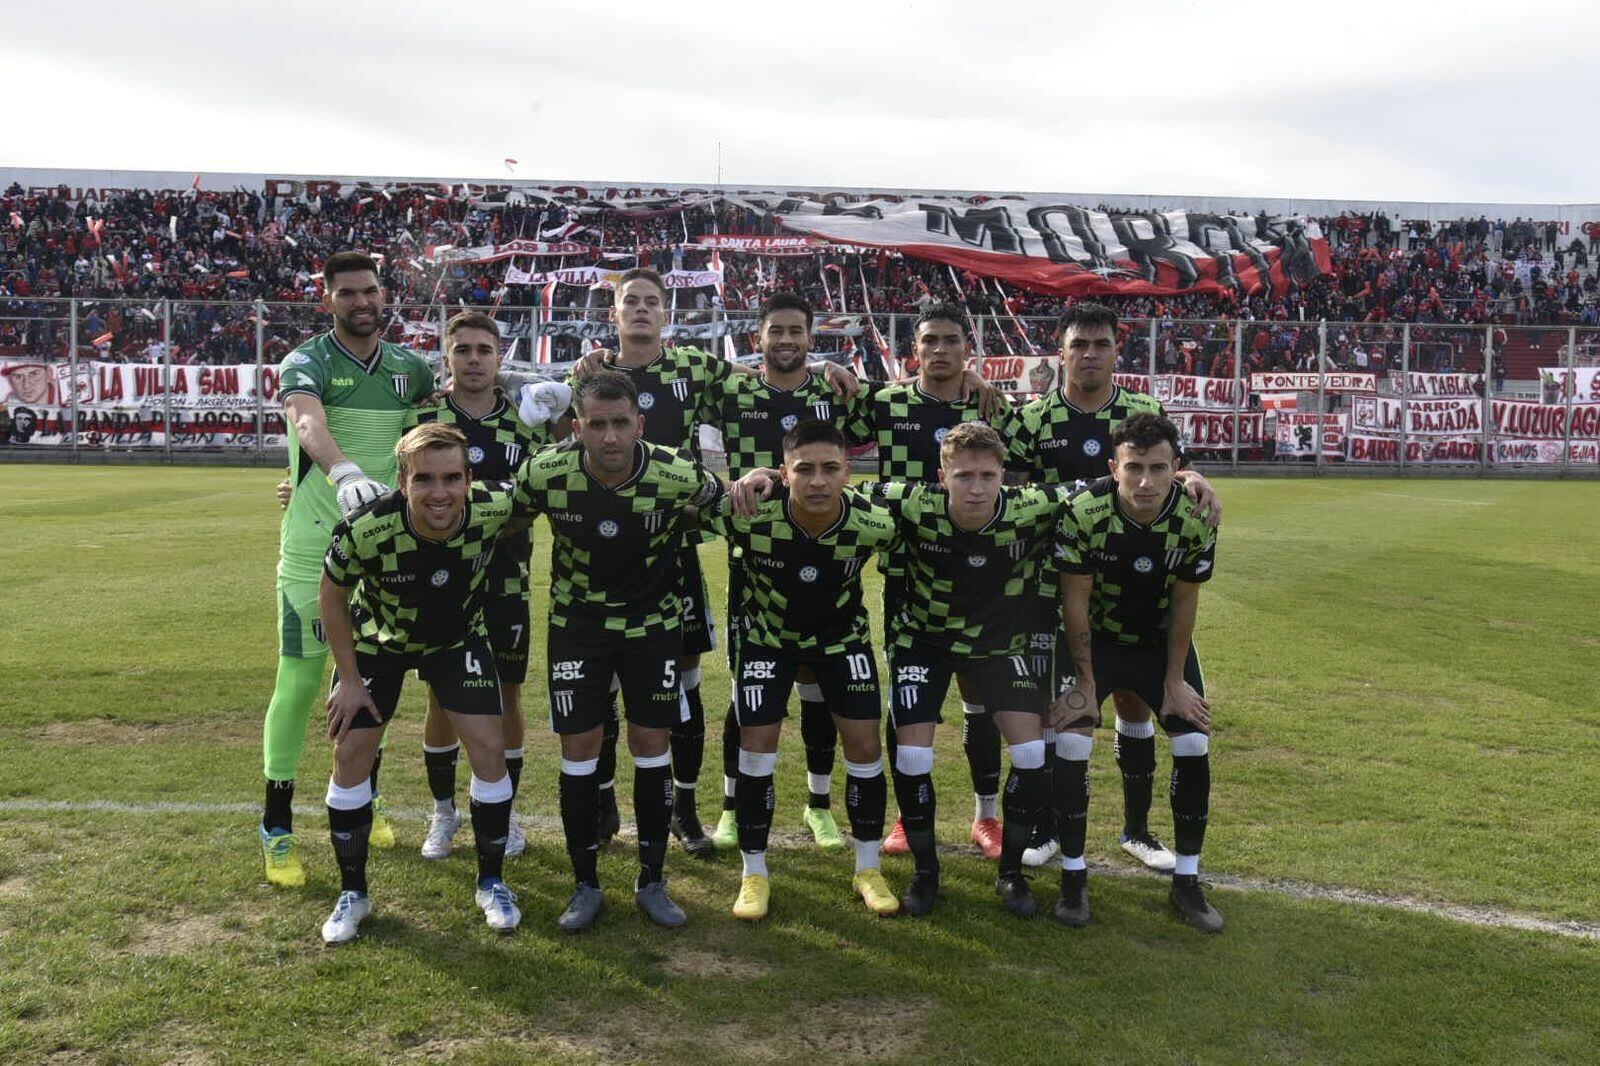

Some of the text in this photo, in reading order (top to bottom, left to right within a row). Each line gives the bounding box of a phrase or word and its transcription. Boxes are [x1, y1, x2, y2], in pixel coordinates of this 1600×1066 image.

[720, 237, 761, 248] SANTA
[528, 272, 552, 283] LA
[555, 270, 600, 284] VILLA
[100, 366, 124, 400] LA
[135, 366, 188, 396] VILA
[199, 366, 240, 396] SAN
[1174, 376, 1199, 398] DEL
[1408, 374, 1474, 396] LA TABLA
[741, 411, 769, 420] mitre
[1412, 402, 1480, 432] BAJADA
[893, 422, 921, 431] mitre
[1190, 414, 1263, 445] TESEI
[1039, 438, 1069, 450] mitre
[1352, 438, 1421, 461] BARRO
[658, 470, 689, 484] CEOSA
[1085, 502, 1110, 516] CEOSA
[552, 512, 584, 523] mitre
[362, 523, 393, 538] CEOSA
[381, 573, 416, 584] mitre
[683, 596, 696, 621] 2
[510, 624, 524, 649] 7
[466, 651, 482, 675] 4
[846, 653, 872, 681] 10
[553, 670, 585, 681] POL
[662, 659, 676, 688] 5
[743, 670, 777, 679] POL
[897, 674, 929, 684] POL
[463, 679, 495, 688] mitre
[847, 682, 876, 693] mitre
[664, 777, 674, 806] mitre
